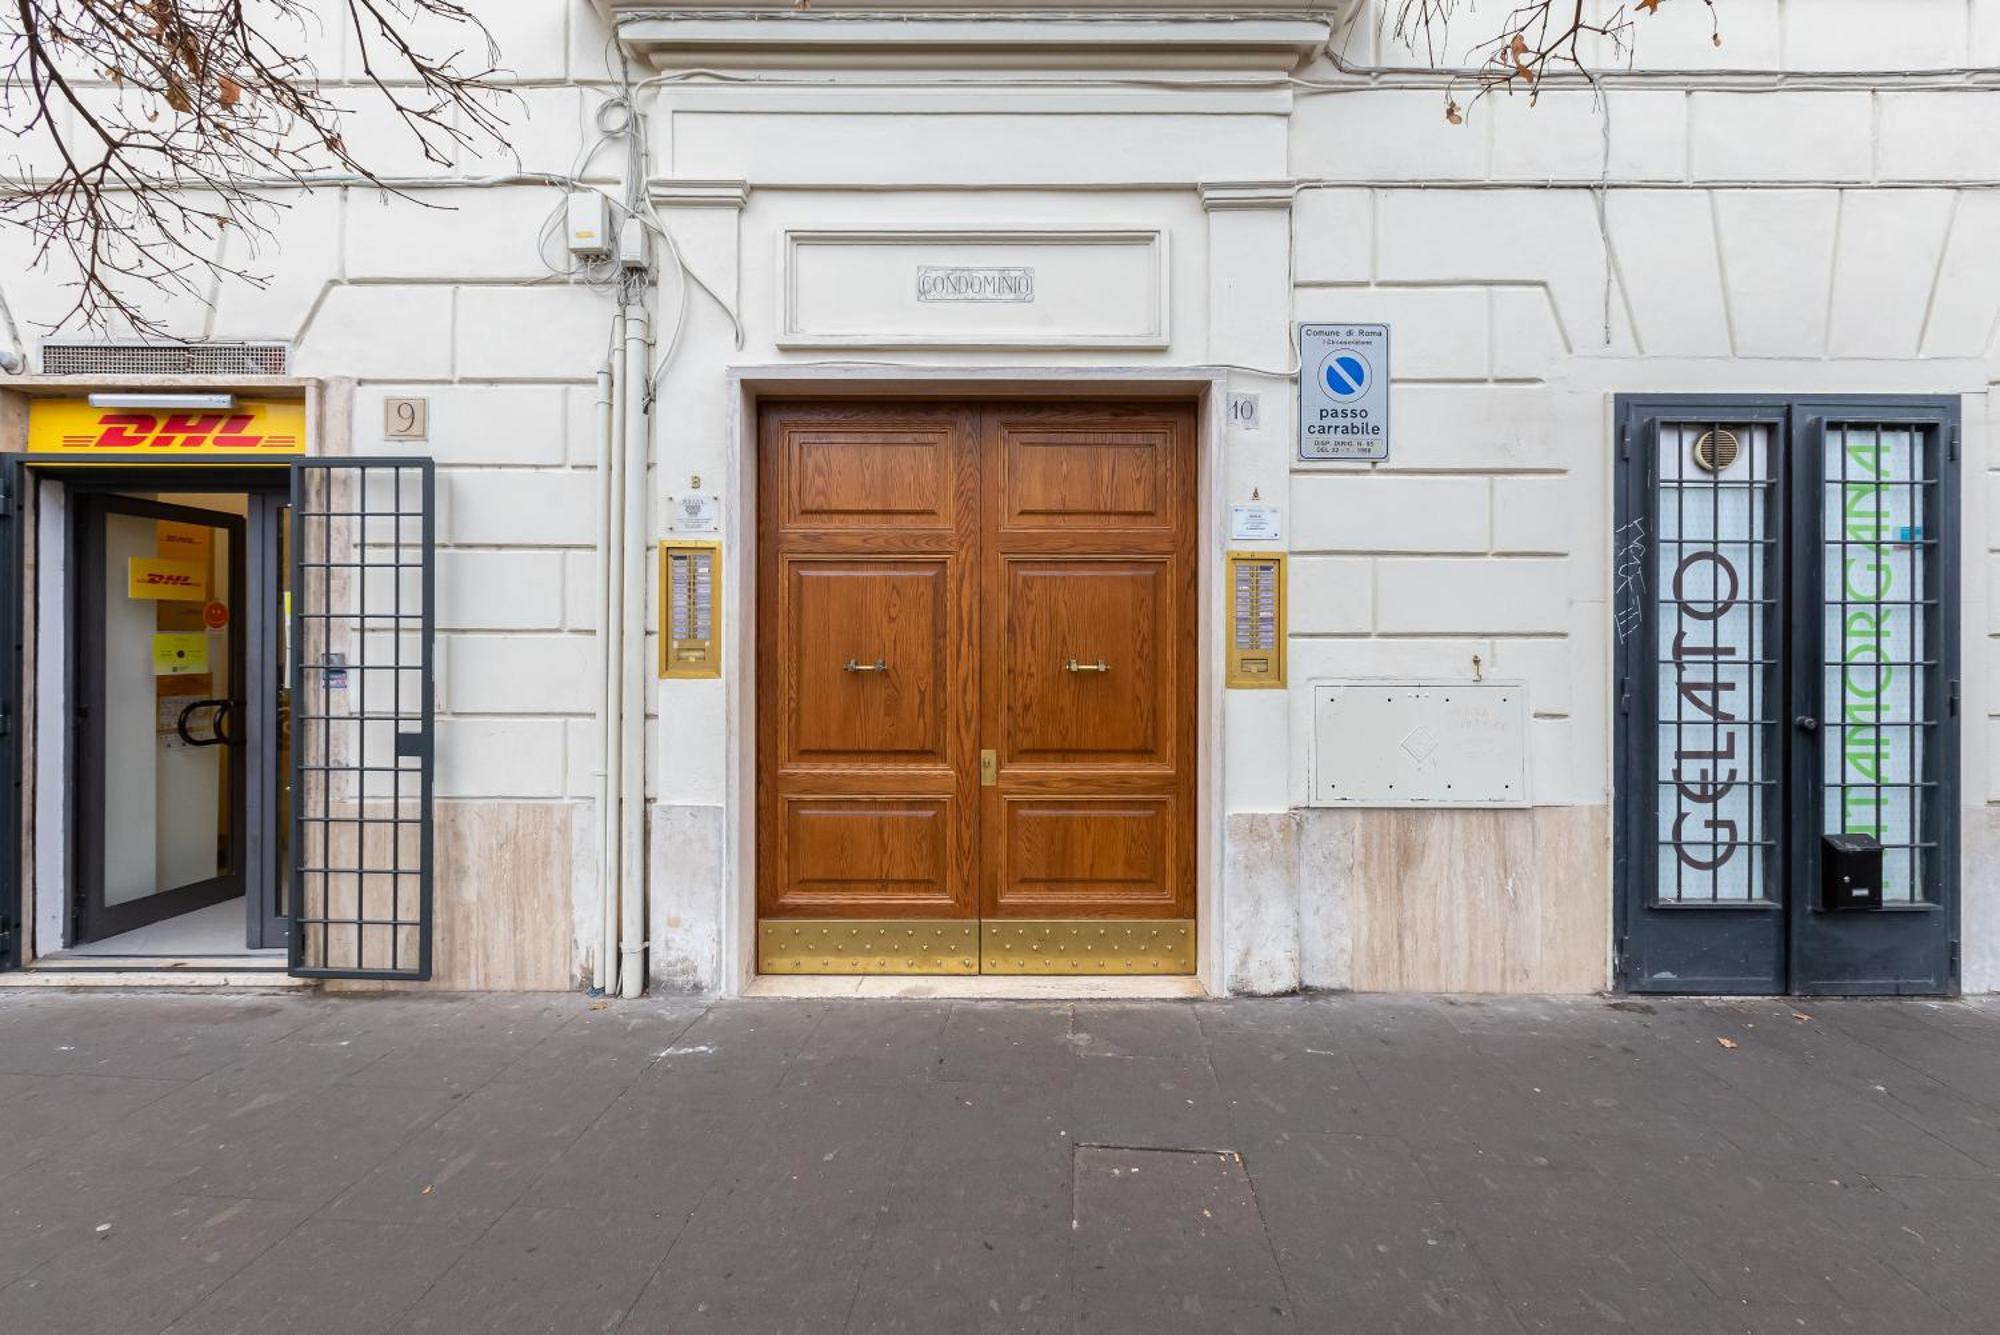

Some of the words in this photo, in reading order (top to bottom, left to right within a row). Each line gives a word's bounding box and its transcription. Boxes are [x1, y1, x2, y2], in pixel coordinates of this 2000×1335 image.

[922, 275, 1030, 294] CONDOMINIO
[1305, 328, 1340, 337] Comune
[1346, 328, 1354, 337] di
[1358, 328, 1383, 337] Roma
[397, 402, 416, 433] 9
[1229, 399, 1254, 421] 10
[1319, 408, 1369, 421] passo
[95, 414, 261, 447] DHL
[1307, 422, 1381, 435] carrabile
[146, 573, 193, 586] DHL
[1844, 443, 1893, 889] ATAMORGANA
[1671, 550, 1739, 871] GELATO
